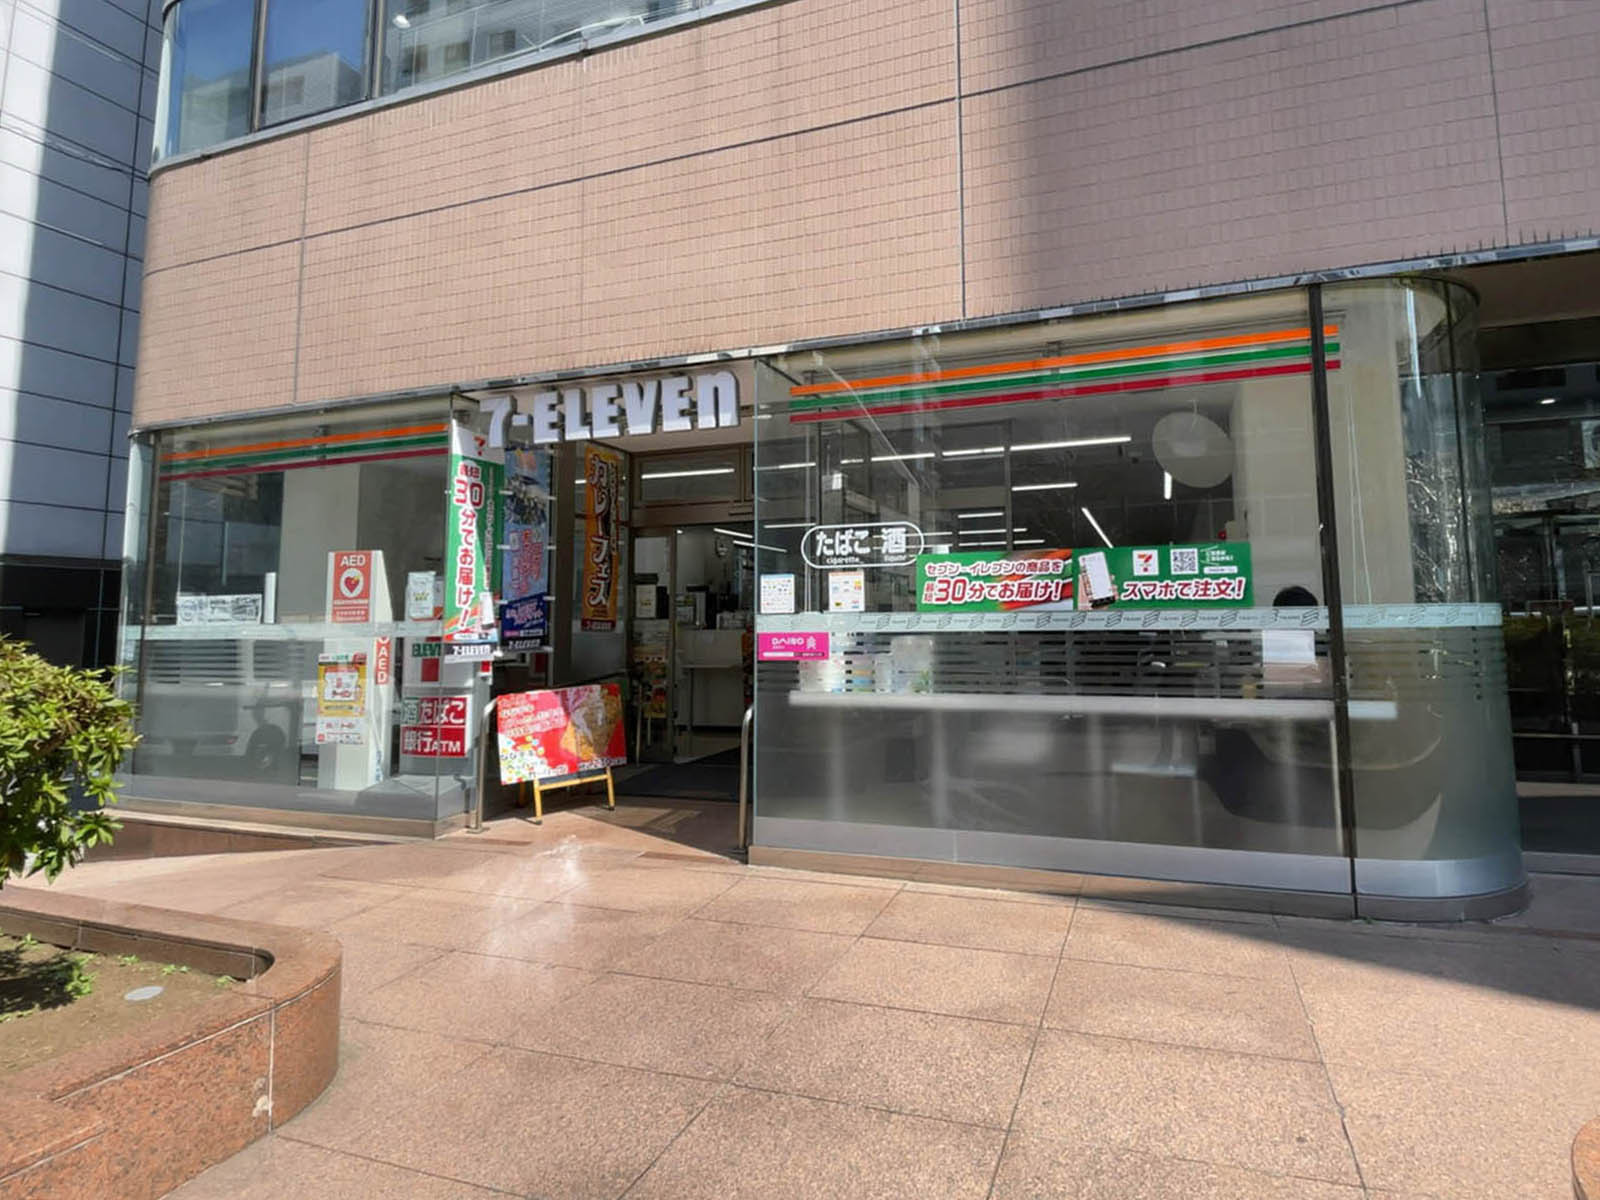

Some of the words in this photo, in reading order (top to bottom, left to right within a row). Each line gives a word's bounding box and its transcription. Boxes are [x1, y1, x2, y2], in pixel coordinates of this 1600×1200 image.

[816, 528, 871, 556] たばこ
[881, 527, 907, 554] 酒
[340, 554, 366, 567] AED
[378, 647, 388, 683] AED
[420, 698, 465, 725] たばこ
